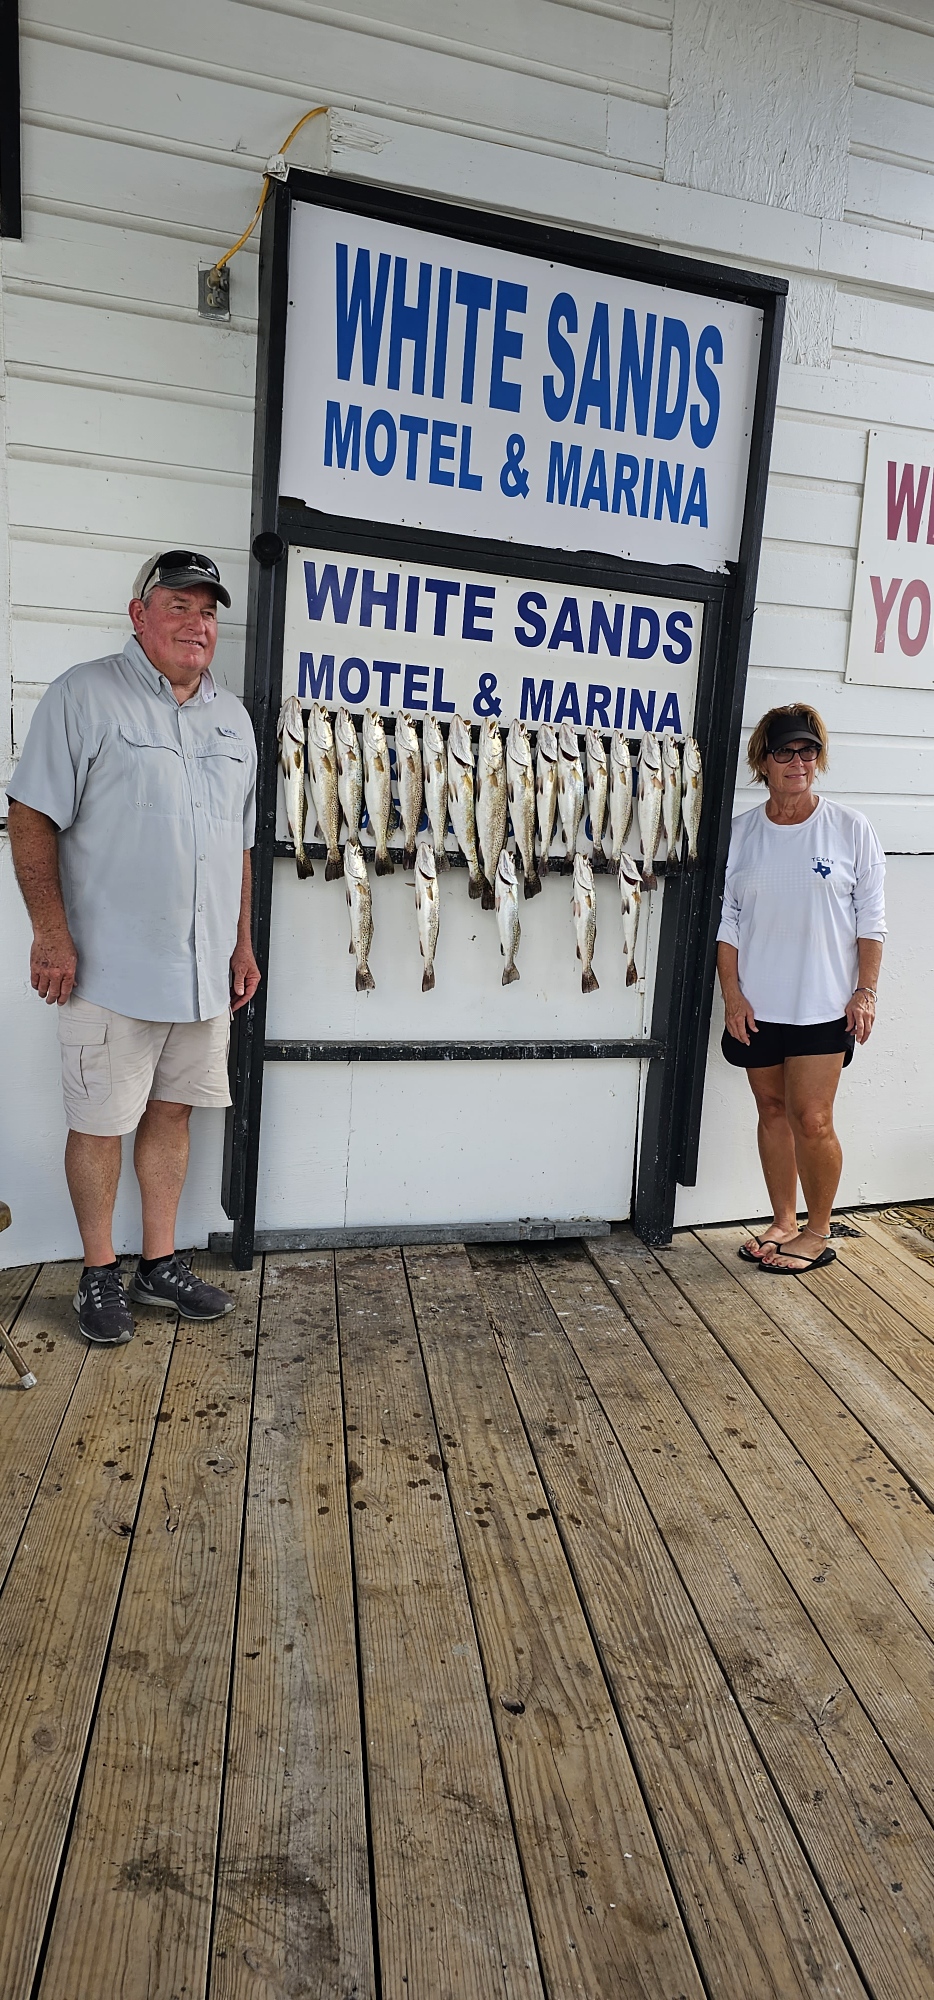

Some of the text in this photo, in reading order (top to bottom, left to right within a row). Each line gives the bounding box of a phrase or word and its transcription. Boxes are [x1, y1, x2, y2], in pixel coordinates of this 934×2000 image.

[336, 243, 724, 449] WHITE SANDS
[324, 400, 709, 528] MOTEL & MARINA
[303, 561, 693, 665] WHITE SANDS
[298, 652, 682, 734] MOTEL & MARINA
